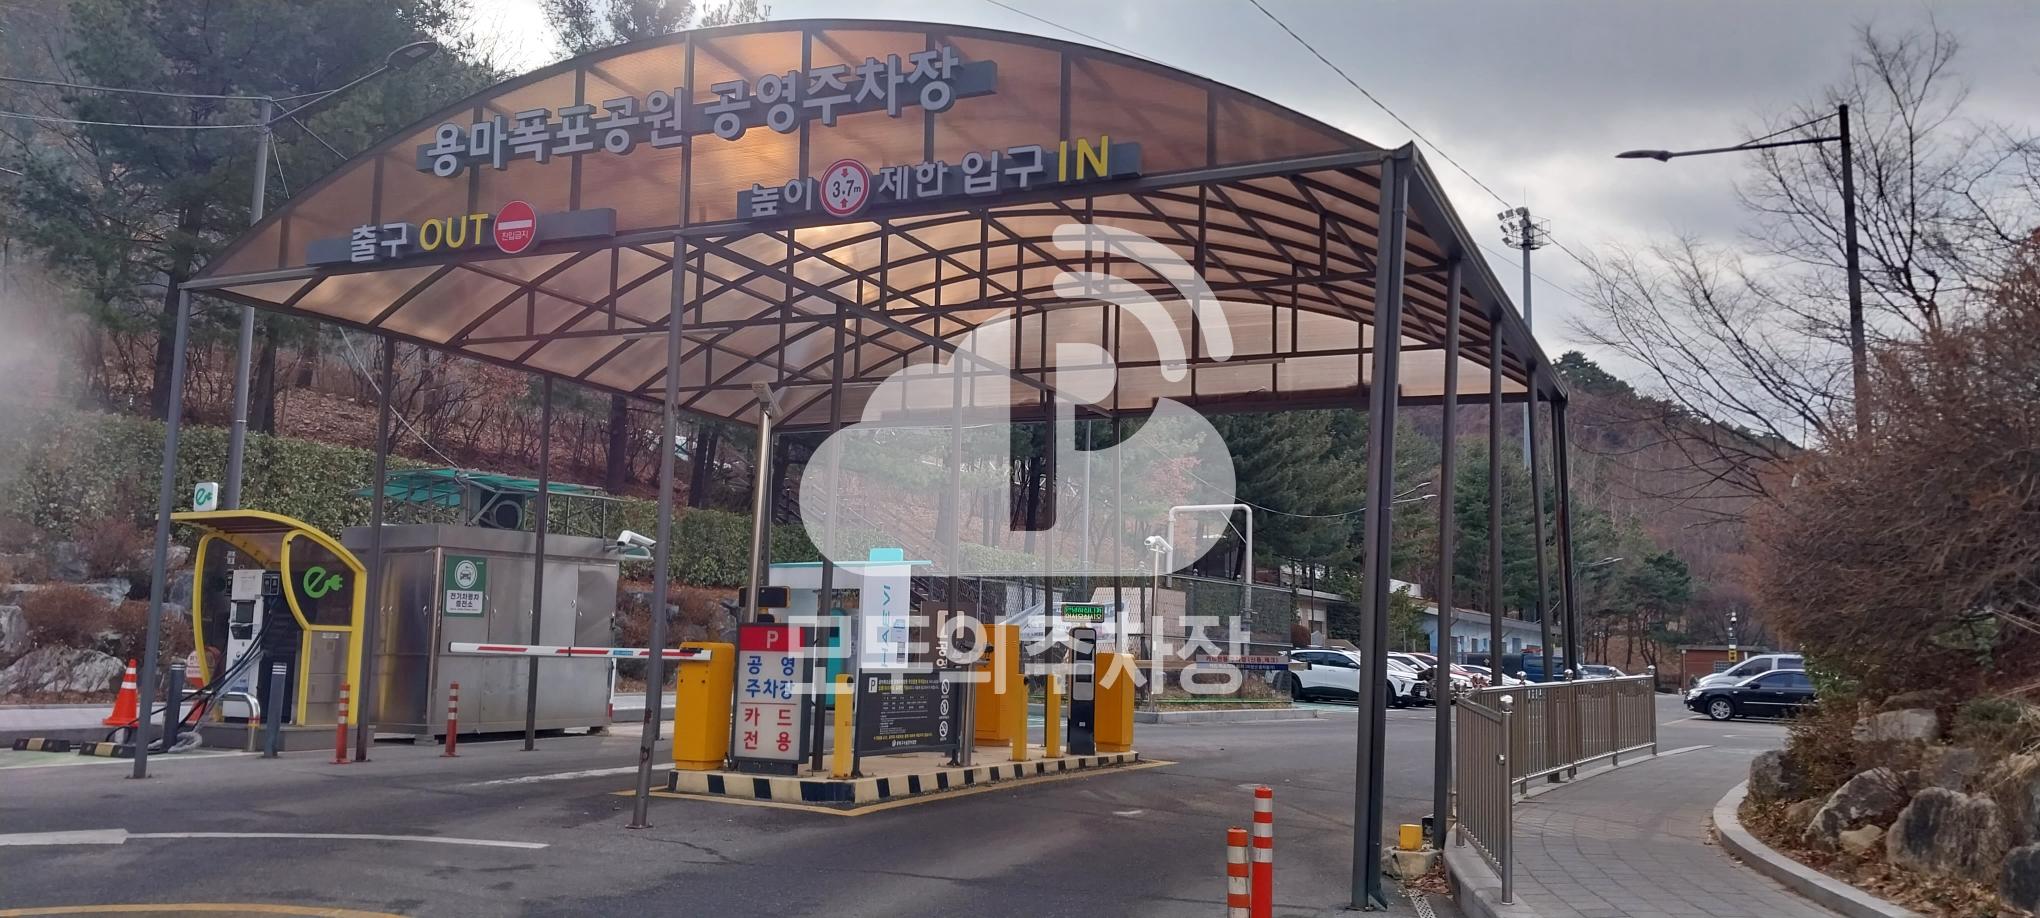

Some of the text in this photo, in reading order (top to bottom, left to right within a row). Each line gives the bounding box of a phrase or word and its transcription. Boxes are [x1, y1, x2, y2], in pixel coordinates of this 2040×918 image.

[426, 46, 959, 177] 용마폭포공원 공영주차장
[752, 135, 1109, 217] 높이 3.7m 제한 입구 IN
[351, 213, 489, 263] 출구 OUT
[502, 230, 529, 241] 진입금지
[766, 630, 778, 649] P
[745, 678, 795, 700] 주차장
